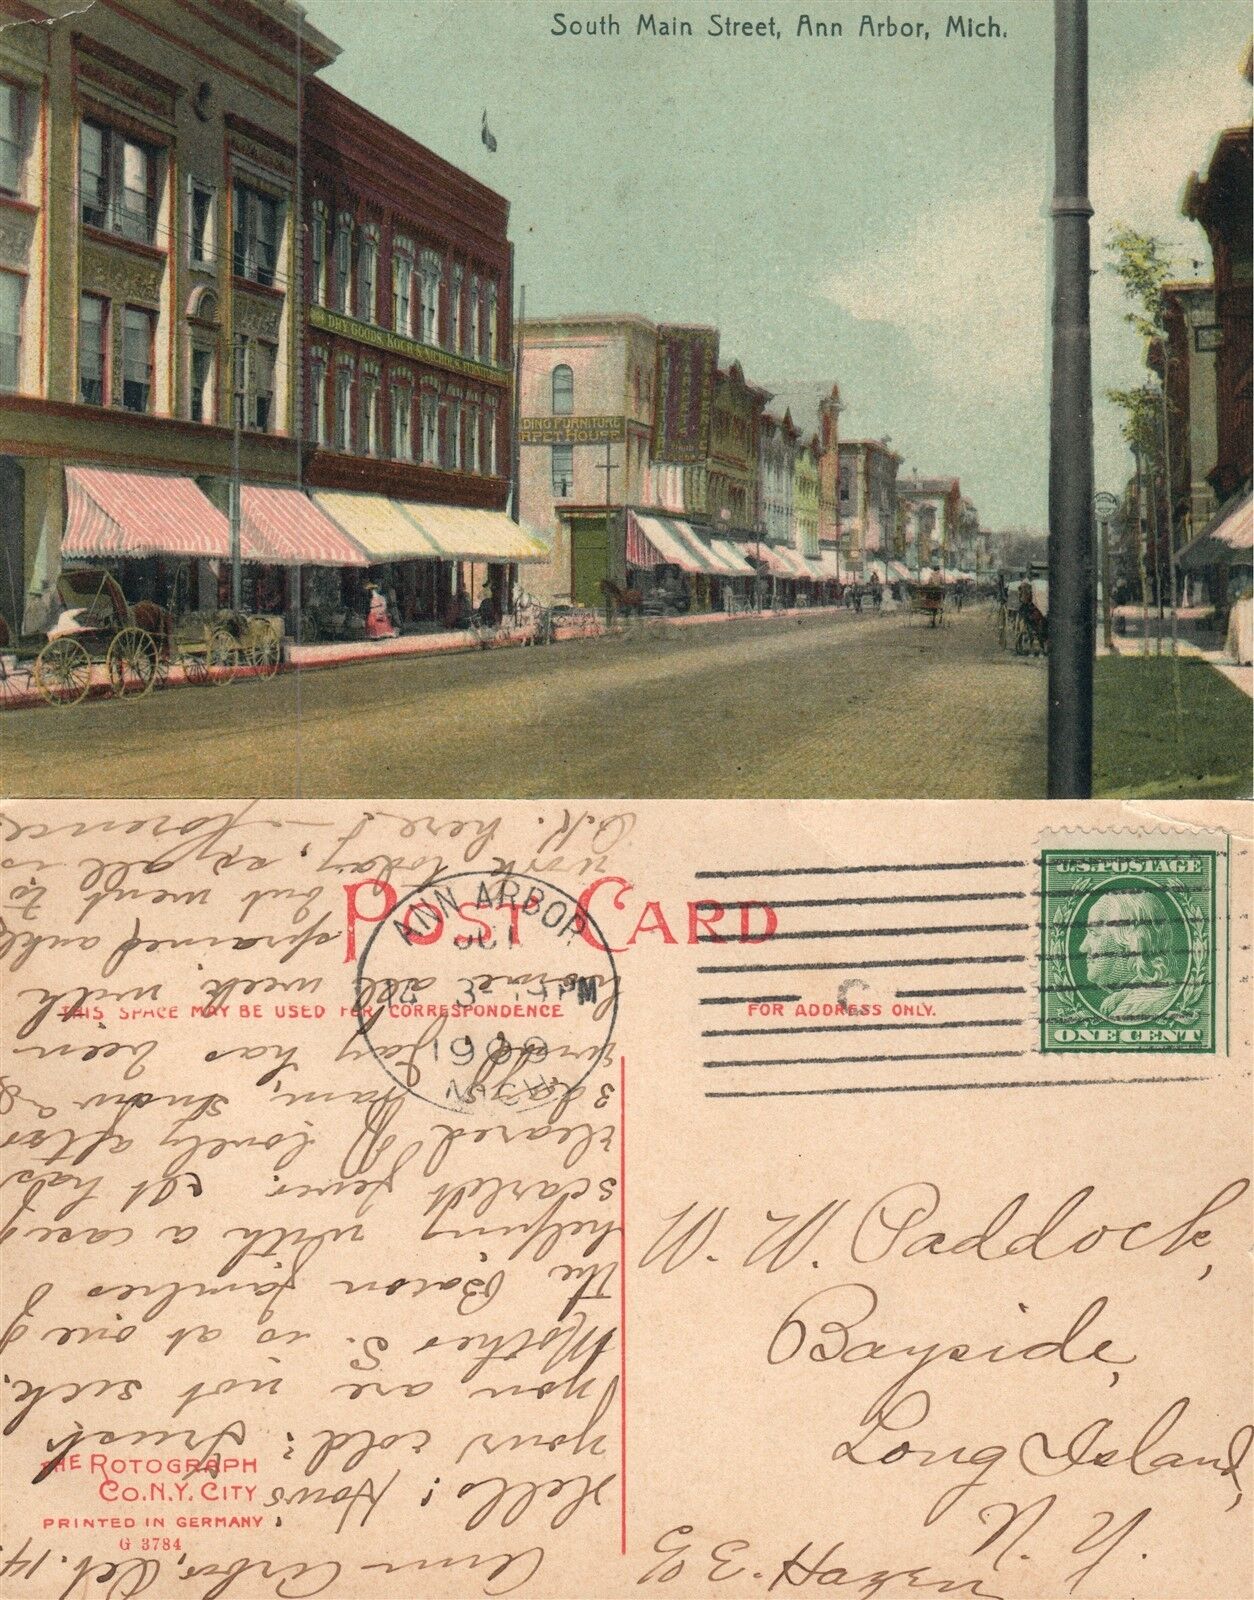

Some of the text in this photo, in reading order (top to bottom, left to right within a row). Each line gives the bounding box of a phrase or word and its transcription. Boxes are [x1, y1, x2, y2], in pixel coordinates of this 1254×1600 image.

[550, 13, 1008, 41] South Main Street, Ann Arbor, Mich.
[78, 860, 174, 892] all
[2, 886, 323, 924] but went to
[343, 876, 778, 964] POST CARD
[393, 885, 460, 946] ANN
[17, 984, 162, 1039] with
[191, 1004, 229, 1020] MAY
[239, 1004, 263, 1020] BE
[275, 1004, 326, 1020] USED
[389, 1003, 565, 1018] CORRESPONDENCE
[200, 977, 323, 1019] week
[748, 1003, 937, 1017] FOR ADDRESS ONLY.
[1053, 1029, 1202, 1042] ONE CENT
[205, 1046, 298, 1087] has
[593, 1083, 615, 1109] 3
[159, 1119, 315, 1178] lovely
[422, 1124, 615, 1177] cleared
[0, 1169, 104, 1221] has
[25, 1226, 134, 1246] case
[155, 1226, 198, 1245] a
[420, 1190, 623, 1262] helping
[217, 1224, 365, 1277] with
[41, 1325, 137, 1346] one
[163, 1325, 222, 1356] at
[256, 1329, 310, 1363] is
[767, 1284, 1138, 1426] Bayside,
[172, 1378, 283, 1418] not
[330, 1380, 434, 1401] are
[455, 1374, 619, 1464] your
[90, 1454, 258, 1475] ROTOGRAPH
[832, 1390, 1007, 1526] Long
[200, 1481, 258, 1502] CITY
[43, 1516, 264, 1529] PRINTED IN GERMANY
[119, 1537, 182, 1551] G 3784
[361, 1548, 544, 1596] Ann
